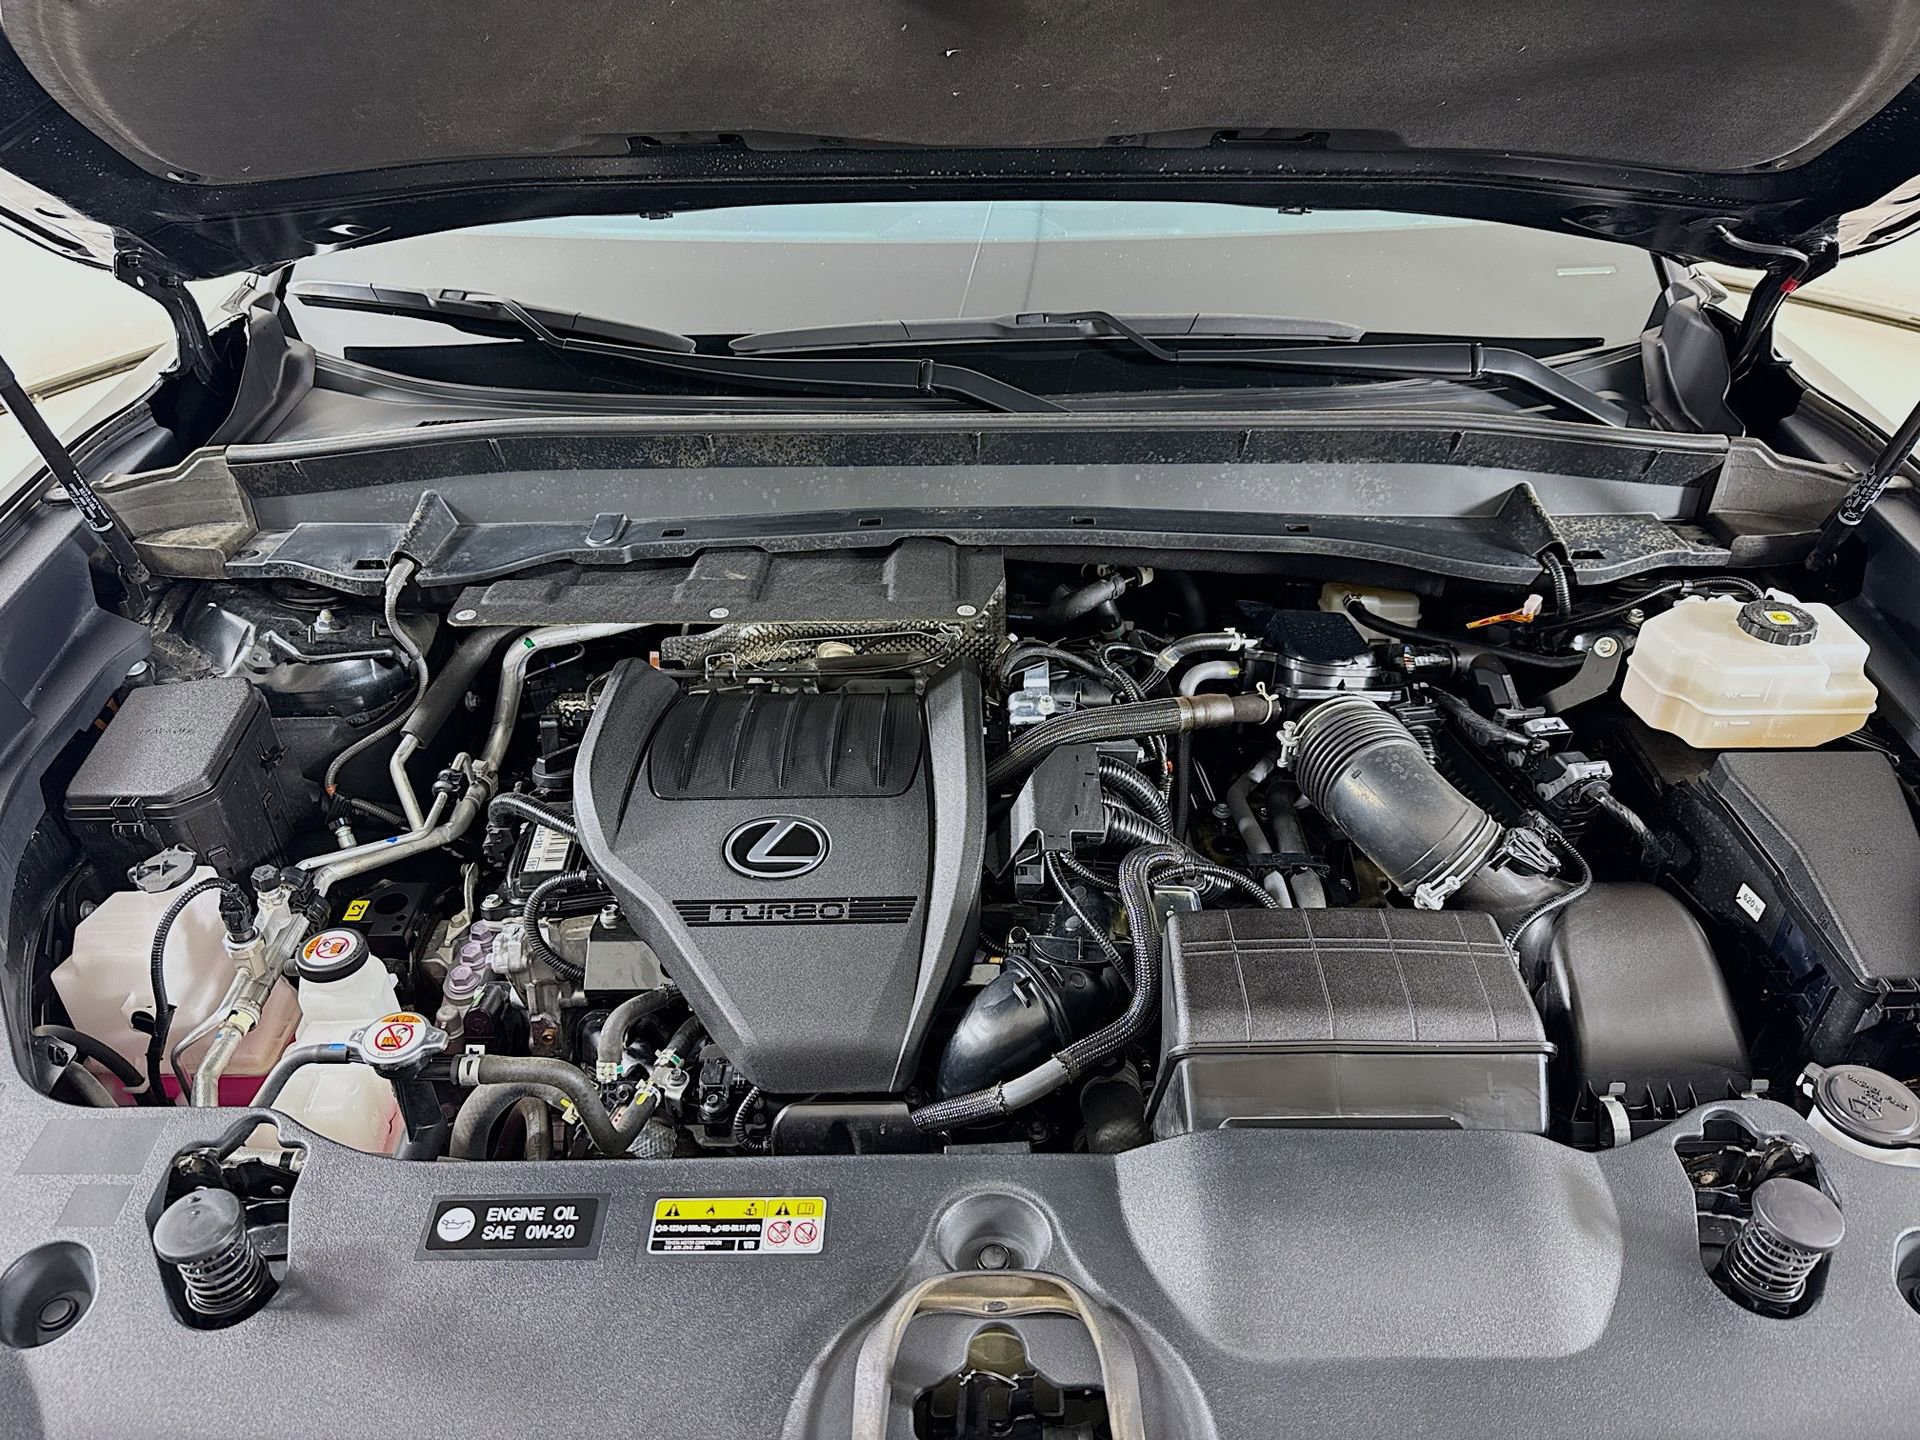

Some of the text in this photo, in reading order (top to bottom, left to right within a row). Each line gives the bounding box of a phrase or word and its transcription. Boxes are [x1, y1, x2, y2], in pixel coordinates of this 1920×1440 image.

[347, 904, 366, 917] L2
[713, 902, 846, 920] TURBO
[486, 1206, 579, 1221] ENGINE OIL
[481, 1225, 575, 1240] SAE 0W-20
